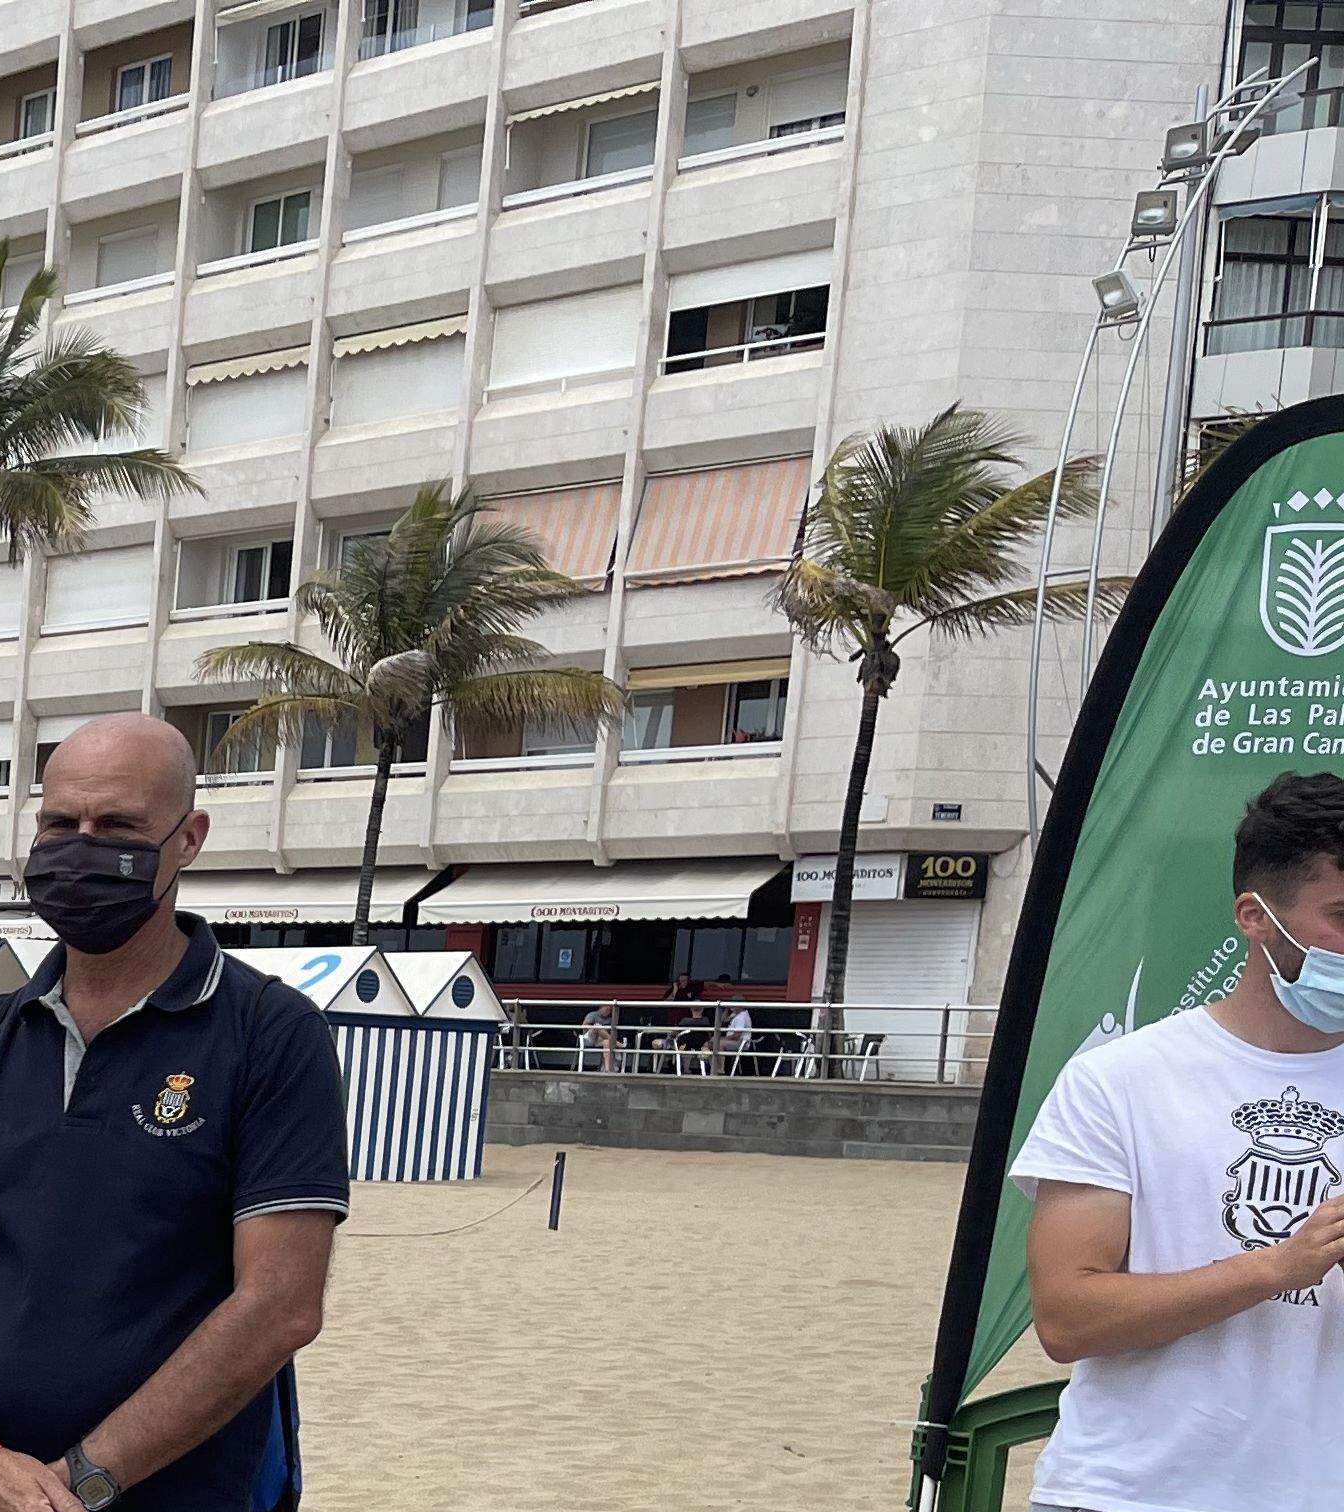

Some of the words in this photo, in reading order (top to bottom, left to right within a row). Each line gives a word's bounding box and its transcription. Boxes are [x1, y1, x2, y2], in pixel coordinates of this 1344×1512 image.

[1197, 675, 1344, 704] Ayuntami
[1195, 704, 1231, 727] de
[1248, 703, 1292, 726] Las
[1308, 703, 1344, 726] Pal
[1192, 732, 1226, 755] de
[1233, 731, 1295, 754] Gran
[1302, 732, 1344, 755] Can
[797, 871, 819, 882] 100
[921, 856, 977, 879] 100
